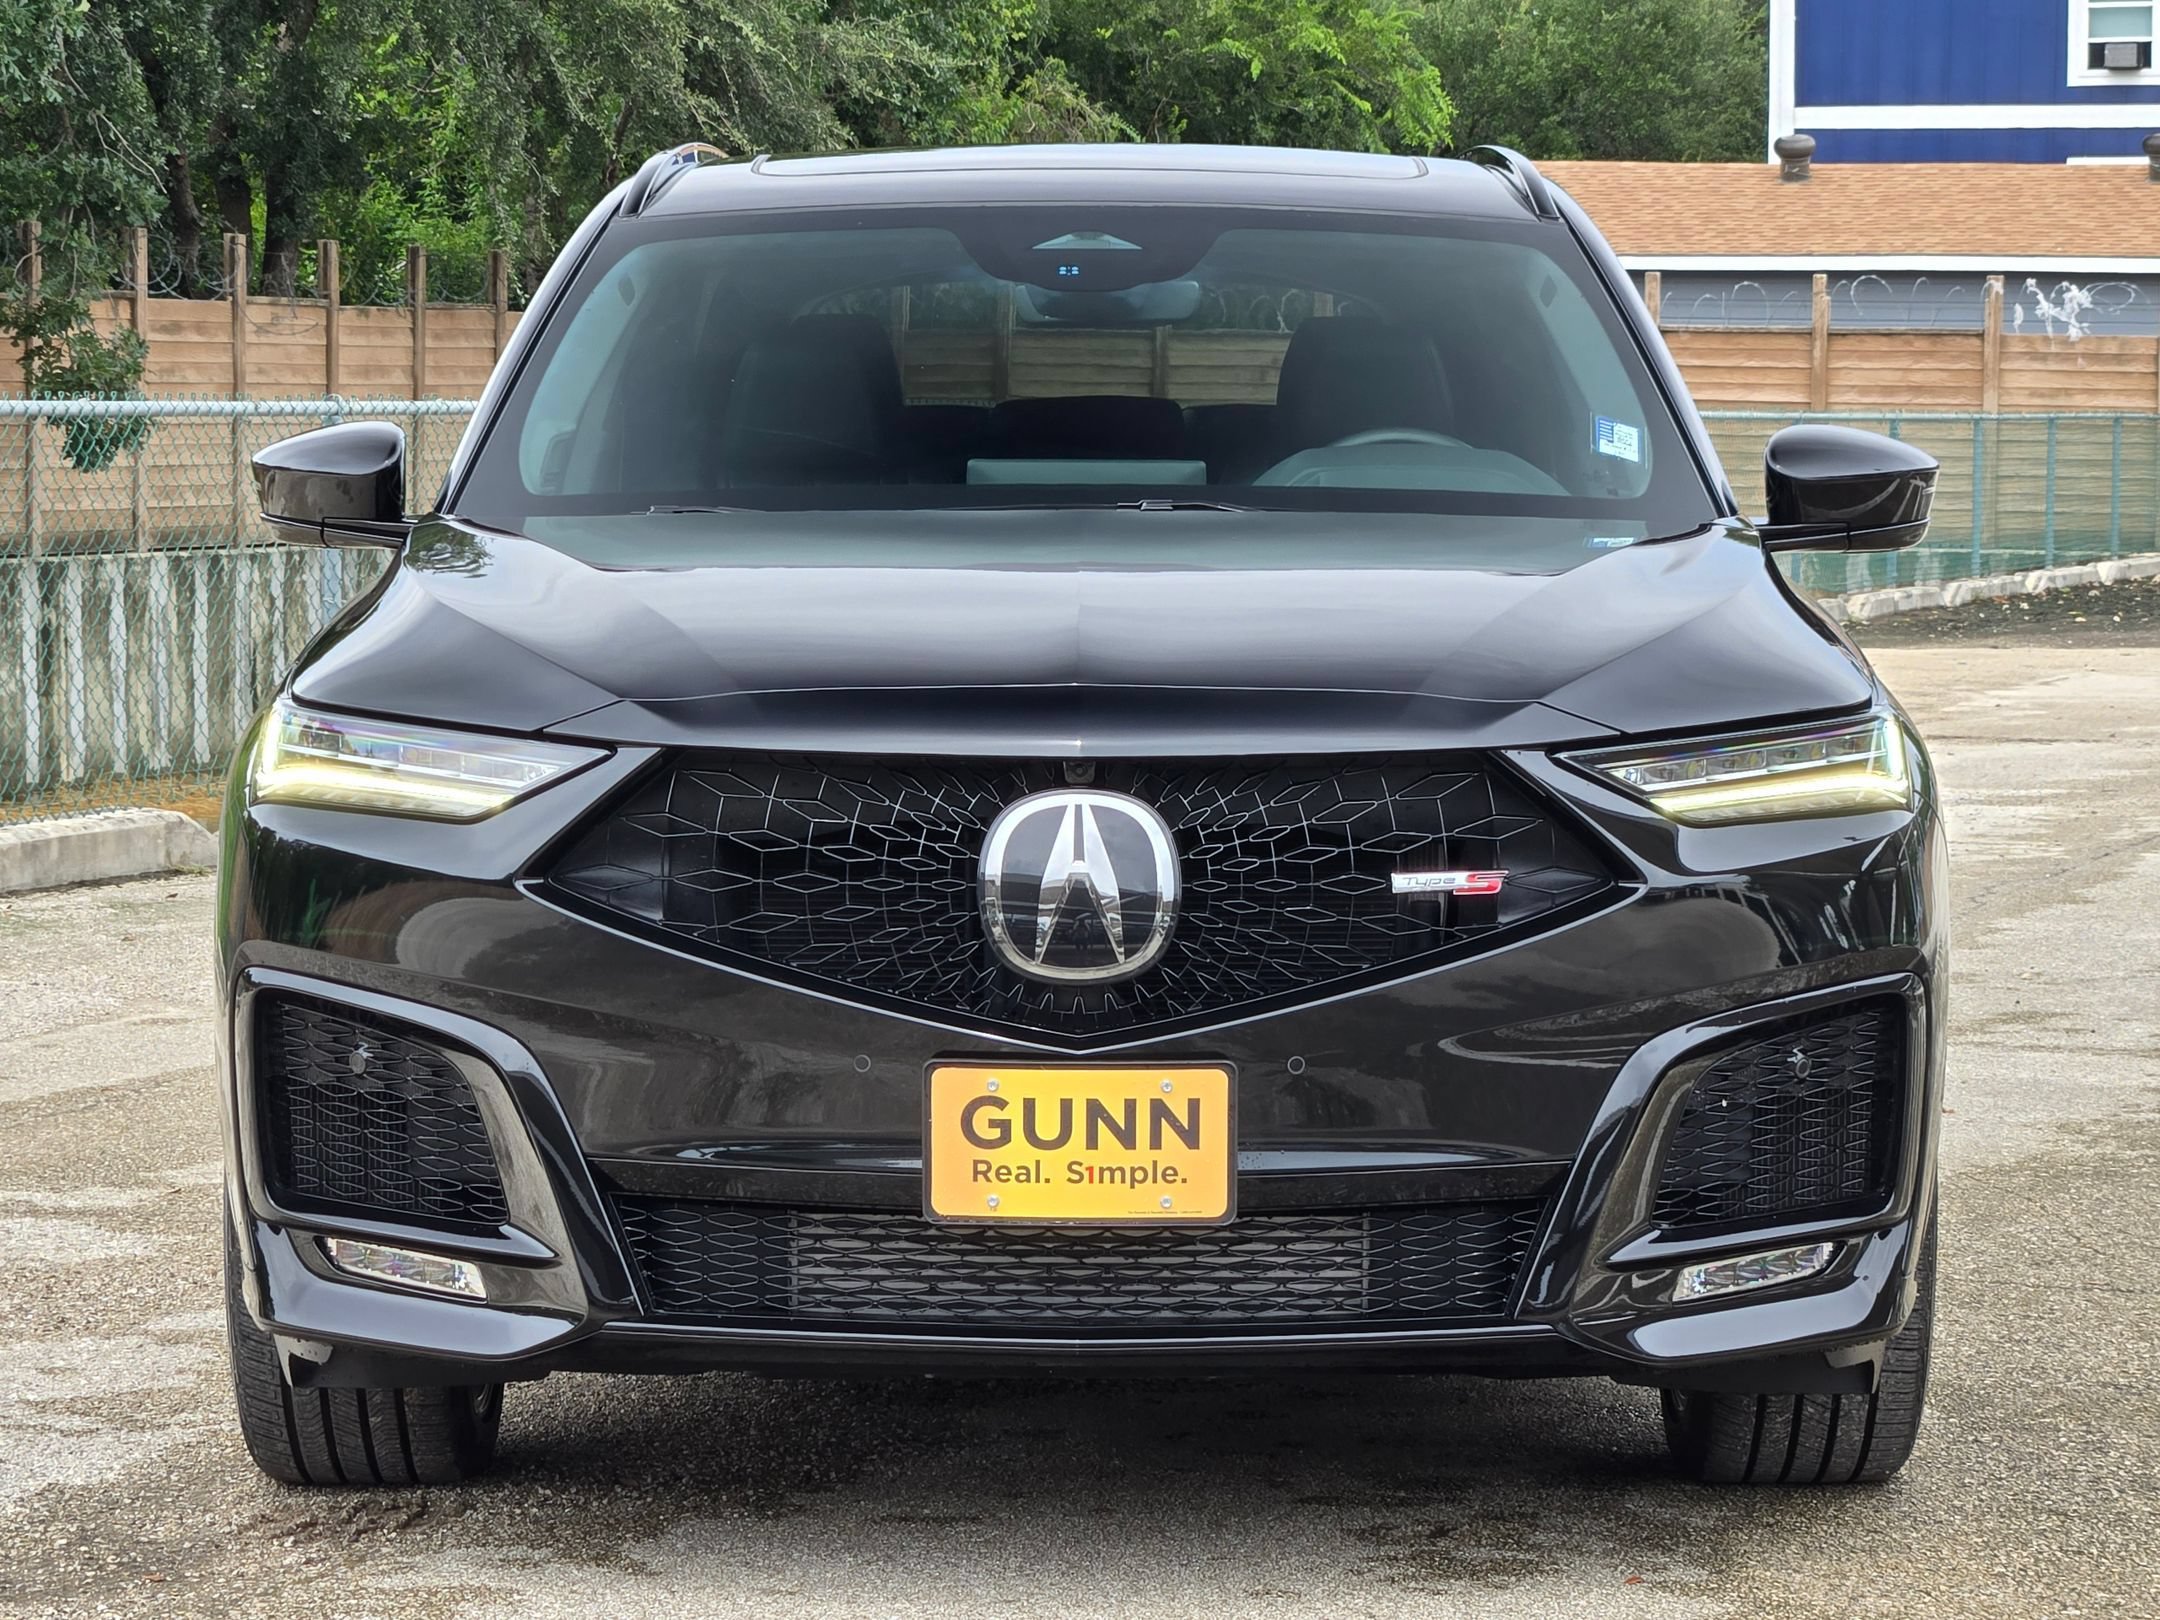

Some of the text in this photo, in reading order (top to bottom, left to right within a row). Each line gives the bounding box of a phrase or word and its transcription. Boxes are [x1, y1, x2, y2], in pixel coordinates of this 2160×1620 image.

[1402, 870, 1509, 895] Type S
[960, 1095, 1200, 1151] GUNN
[972, 1159, 1188, 1189] Real. S1mple.
